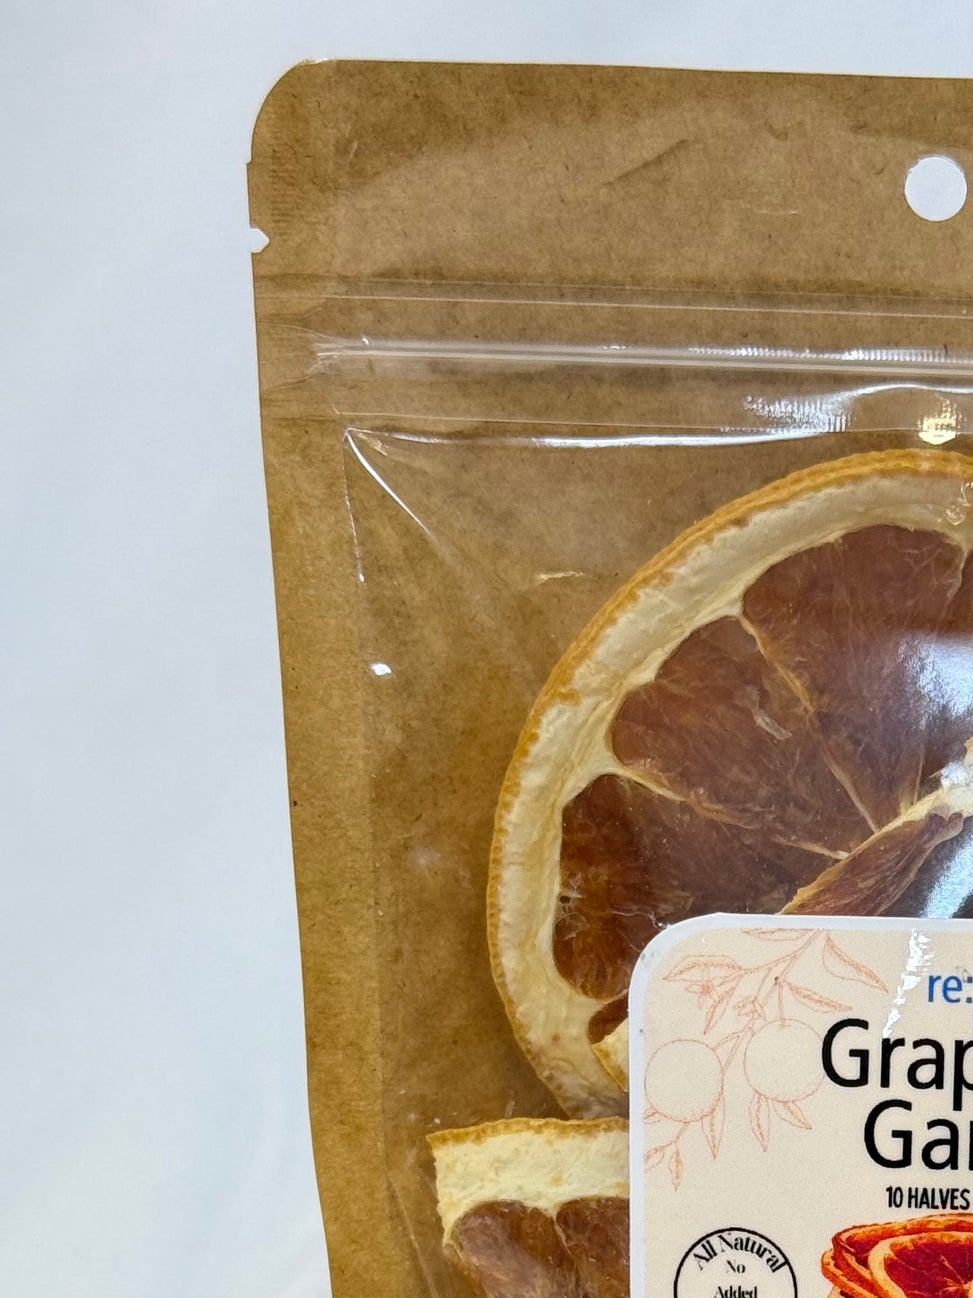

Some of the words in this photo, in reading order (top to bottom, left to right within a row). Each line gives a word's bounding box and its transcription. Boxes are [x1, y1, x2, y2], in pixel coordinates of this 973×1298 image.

[886, 1185, 904, 1208] 10
[908, 1187, 971, 1210] HALVES
[693, 1239, 718, 1271] All
[717, 1232, 788, 1273] Natural
[726, 1259, 746, 1274] No
